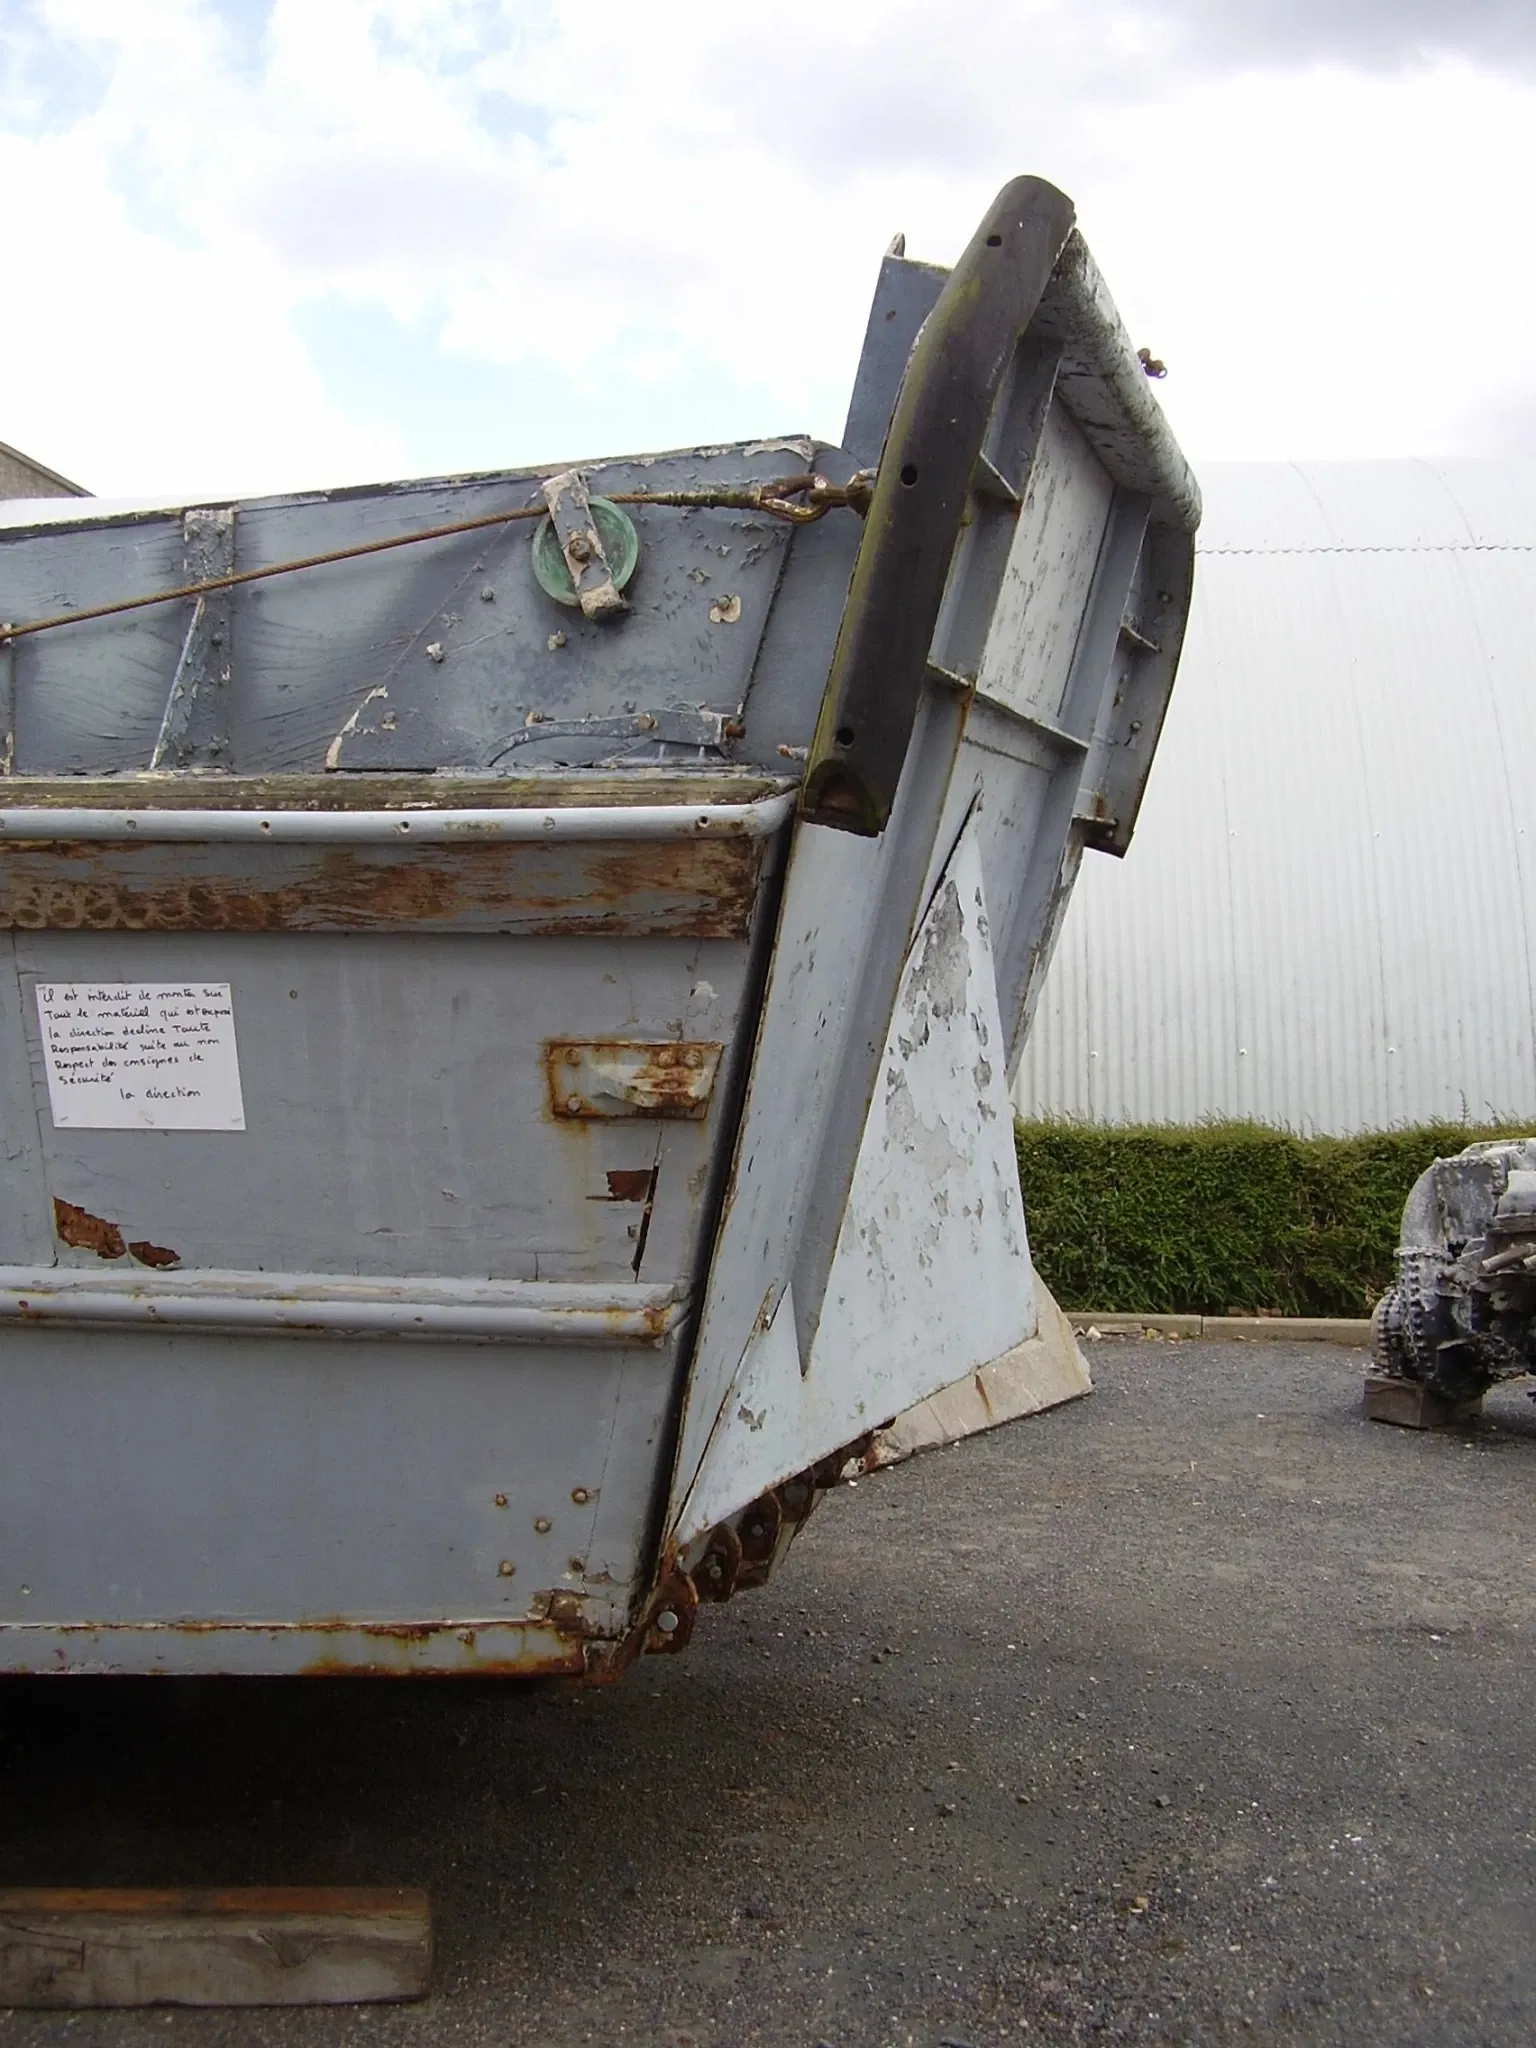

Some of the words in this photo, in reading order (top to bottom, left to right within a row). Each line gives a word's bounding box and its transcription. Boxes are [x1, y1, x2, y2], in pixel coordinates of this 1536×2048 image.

[64, 988, 78, 1001] est
[88, 987, 132, 1001] interdit
[139, 989, 151, 1001] de
[77, 1007, 89, 1018] le
[160, 1006, 180, 1022] qui
[186, 1005, 200, 1016] est
[48, 1026, 60, 1039] la
[69, 1027, 115, 1038] direction
[189, 1053, 204, 1062] de
[146, 1086, 201, 1099] direction
